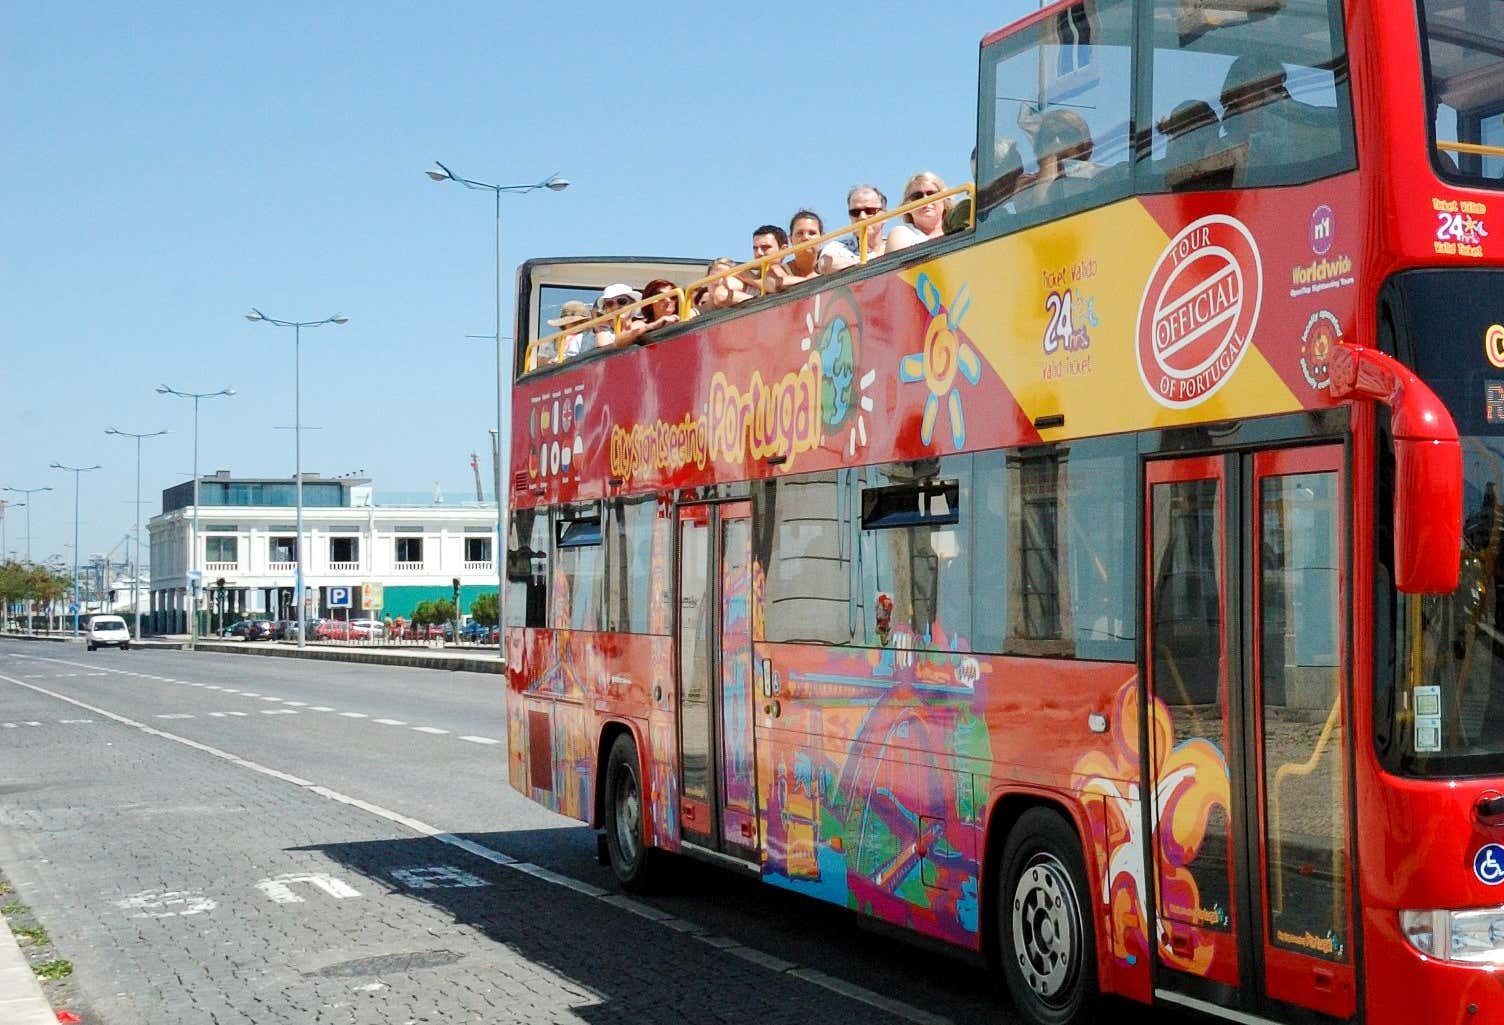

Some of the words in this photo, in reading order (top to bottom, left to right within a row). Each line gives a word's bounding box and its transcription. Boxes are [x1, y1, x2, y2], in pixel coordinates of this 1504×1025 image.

[1170, 227, 1211, 267] TOUR
[1437, 212, 1463, 241] 24
[1043, 288, 1072, 355] 24
[1156, 275, 1240, 349] OFFICIAL
[1160, 375, 1178, 398] OF
[1179, 333, 1245, 399] PORTUGAL
[709, 350, 822, 472] Portugal
[333, 589, 346, 604] P
